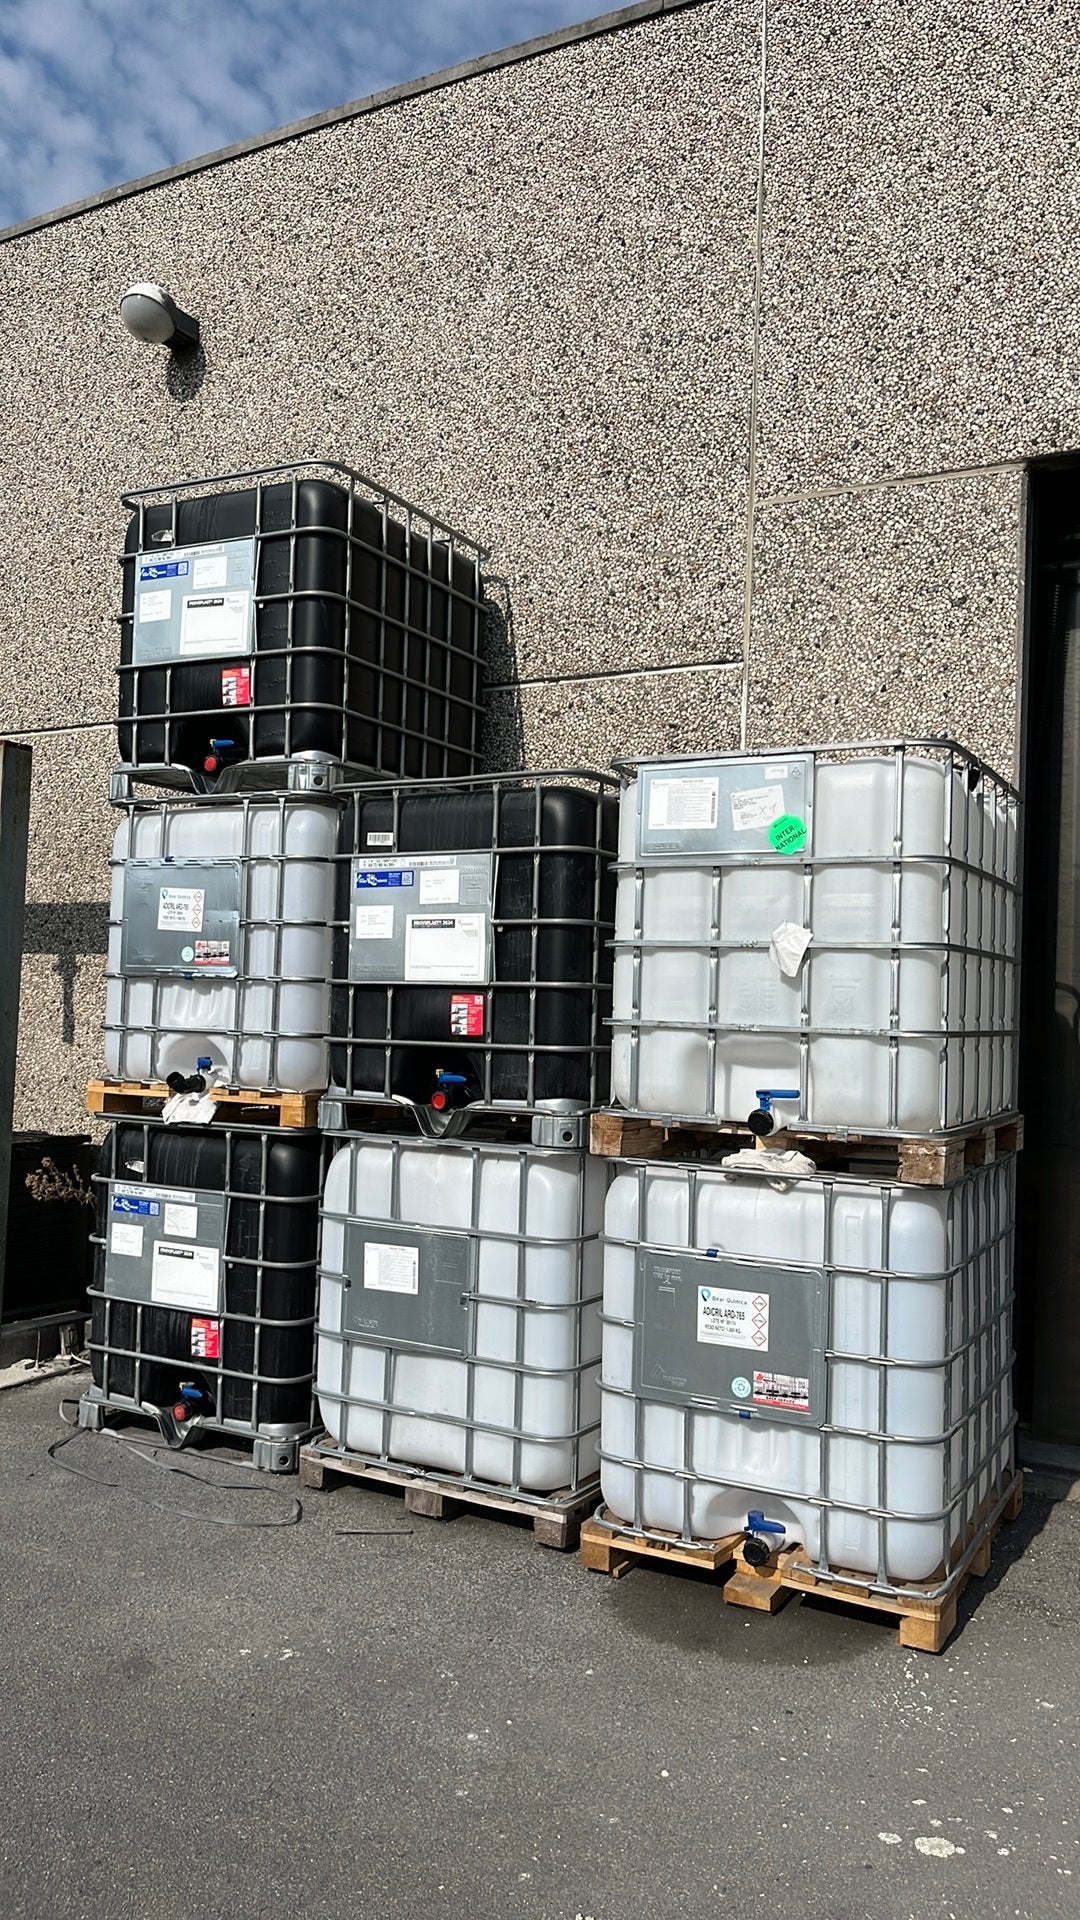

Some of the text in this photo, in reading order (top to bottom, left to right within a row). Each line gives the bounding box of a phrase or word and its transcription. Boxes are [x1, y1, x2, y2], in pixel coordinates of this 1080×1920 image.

[775, 825, 796, 841] INTER-
[775, 828, 807, 850] NATIONAL
[703, 1306, 745, 1321] ADICRIL ARD-765
